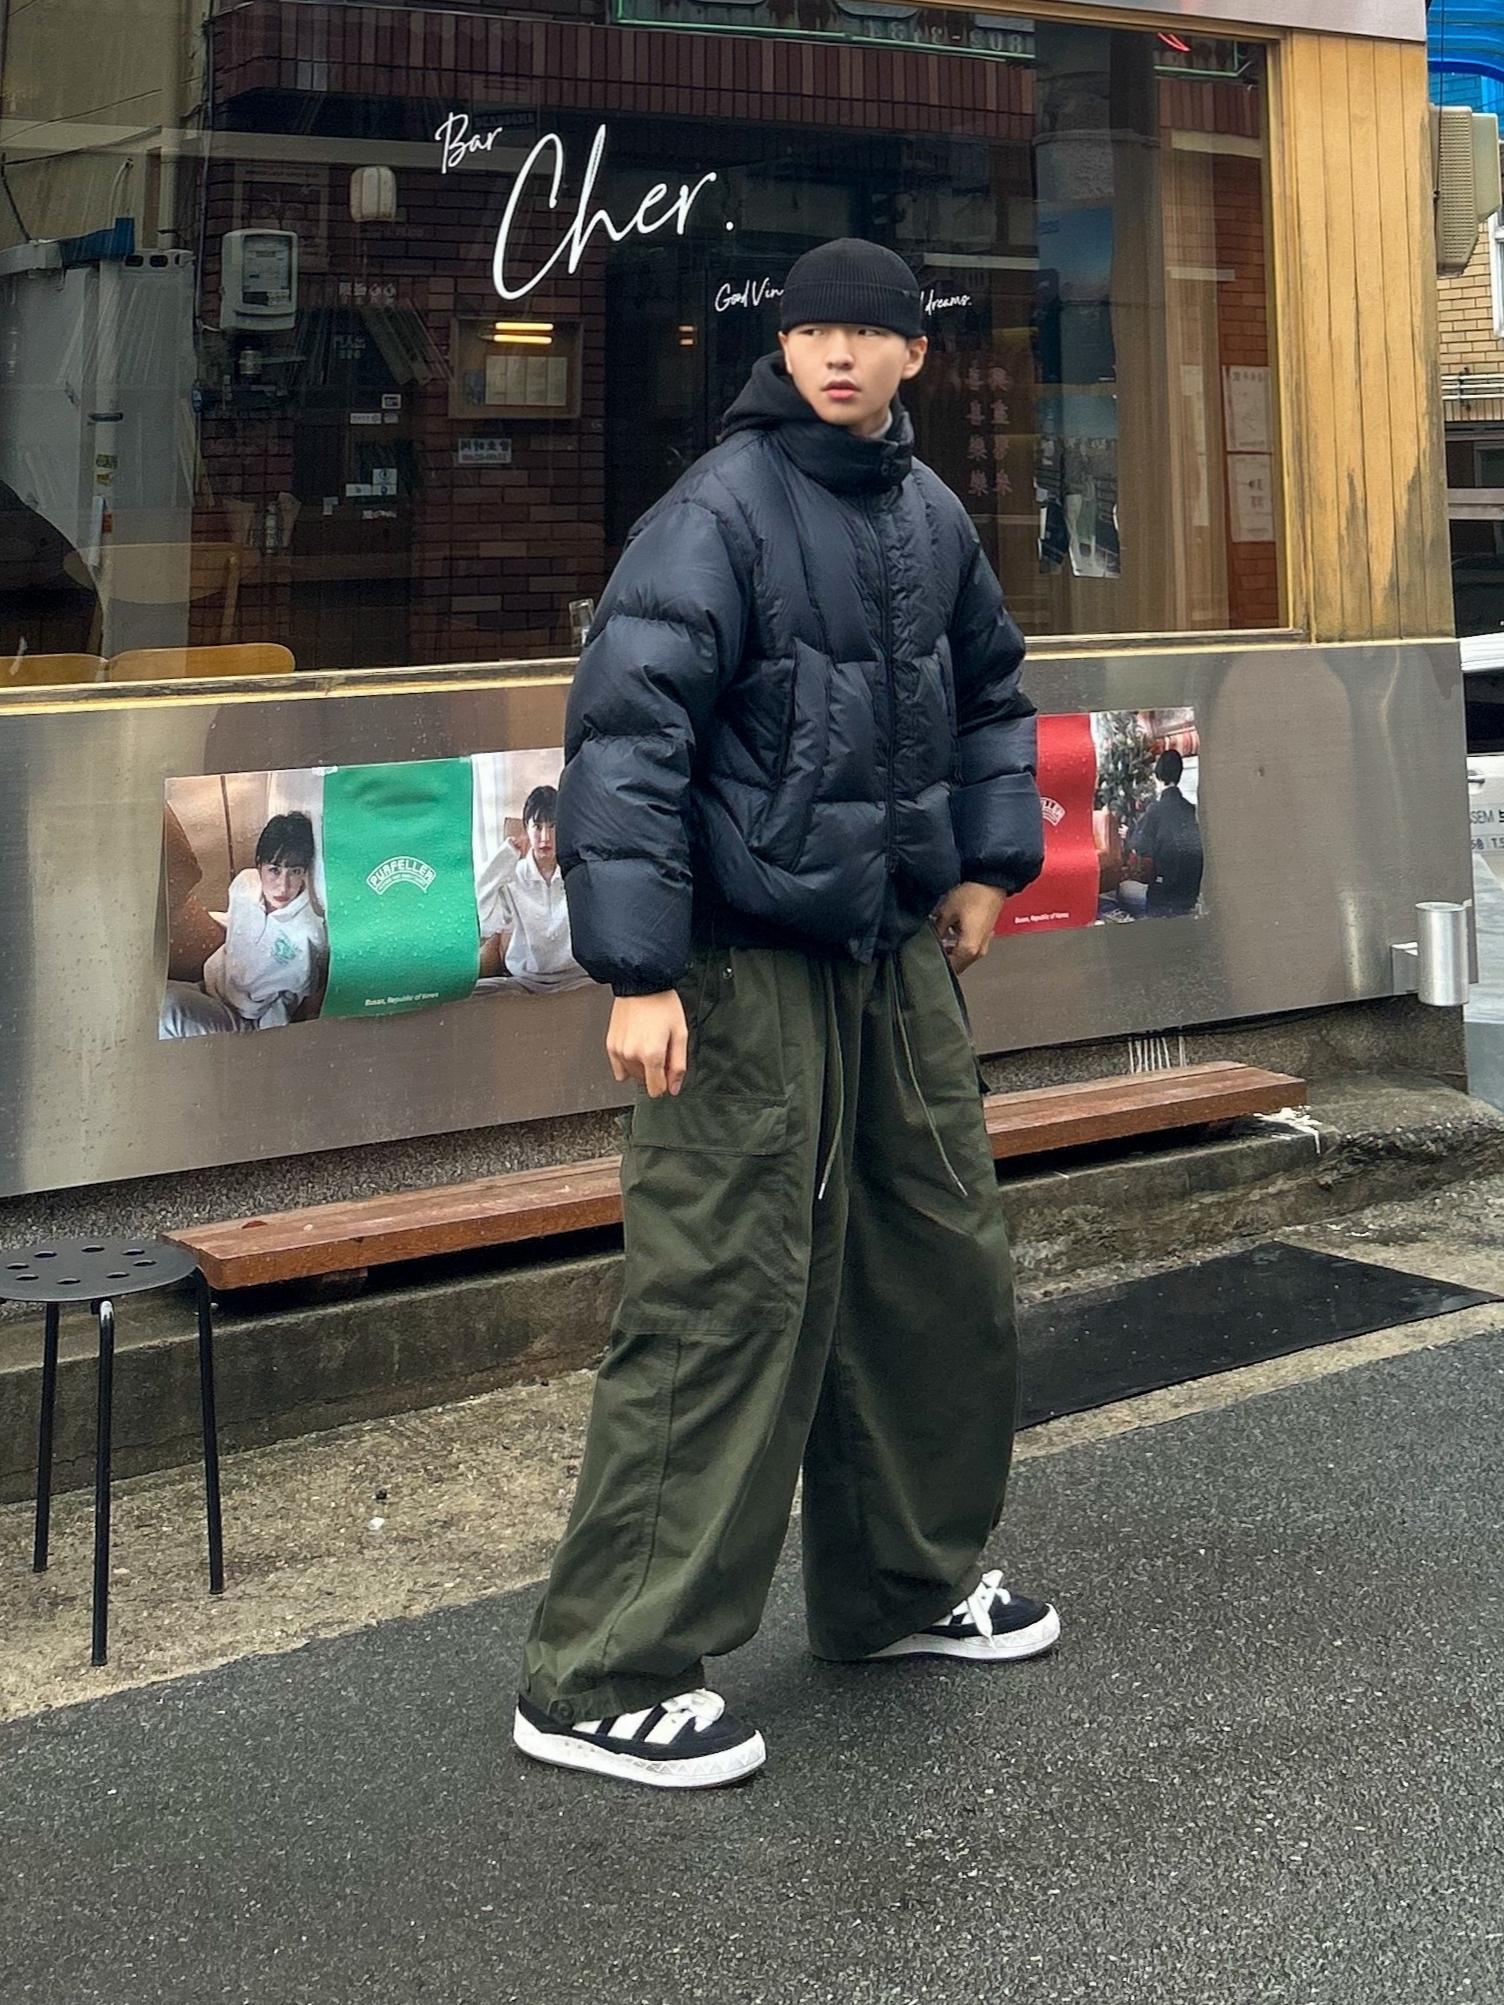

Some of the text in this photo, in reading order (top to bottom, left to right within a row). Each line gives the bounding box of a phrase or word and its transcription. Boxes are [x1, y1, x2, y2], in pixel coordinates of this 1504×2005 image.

[434, 112, 503, 174] Bar
[714, 280, 750, 312] Good
[370, 859, 434, 886] PURFELLER
